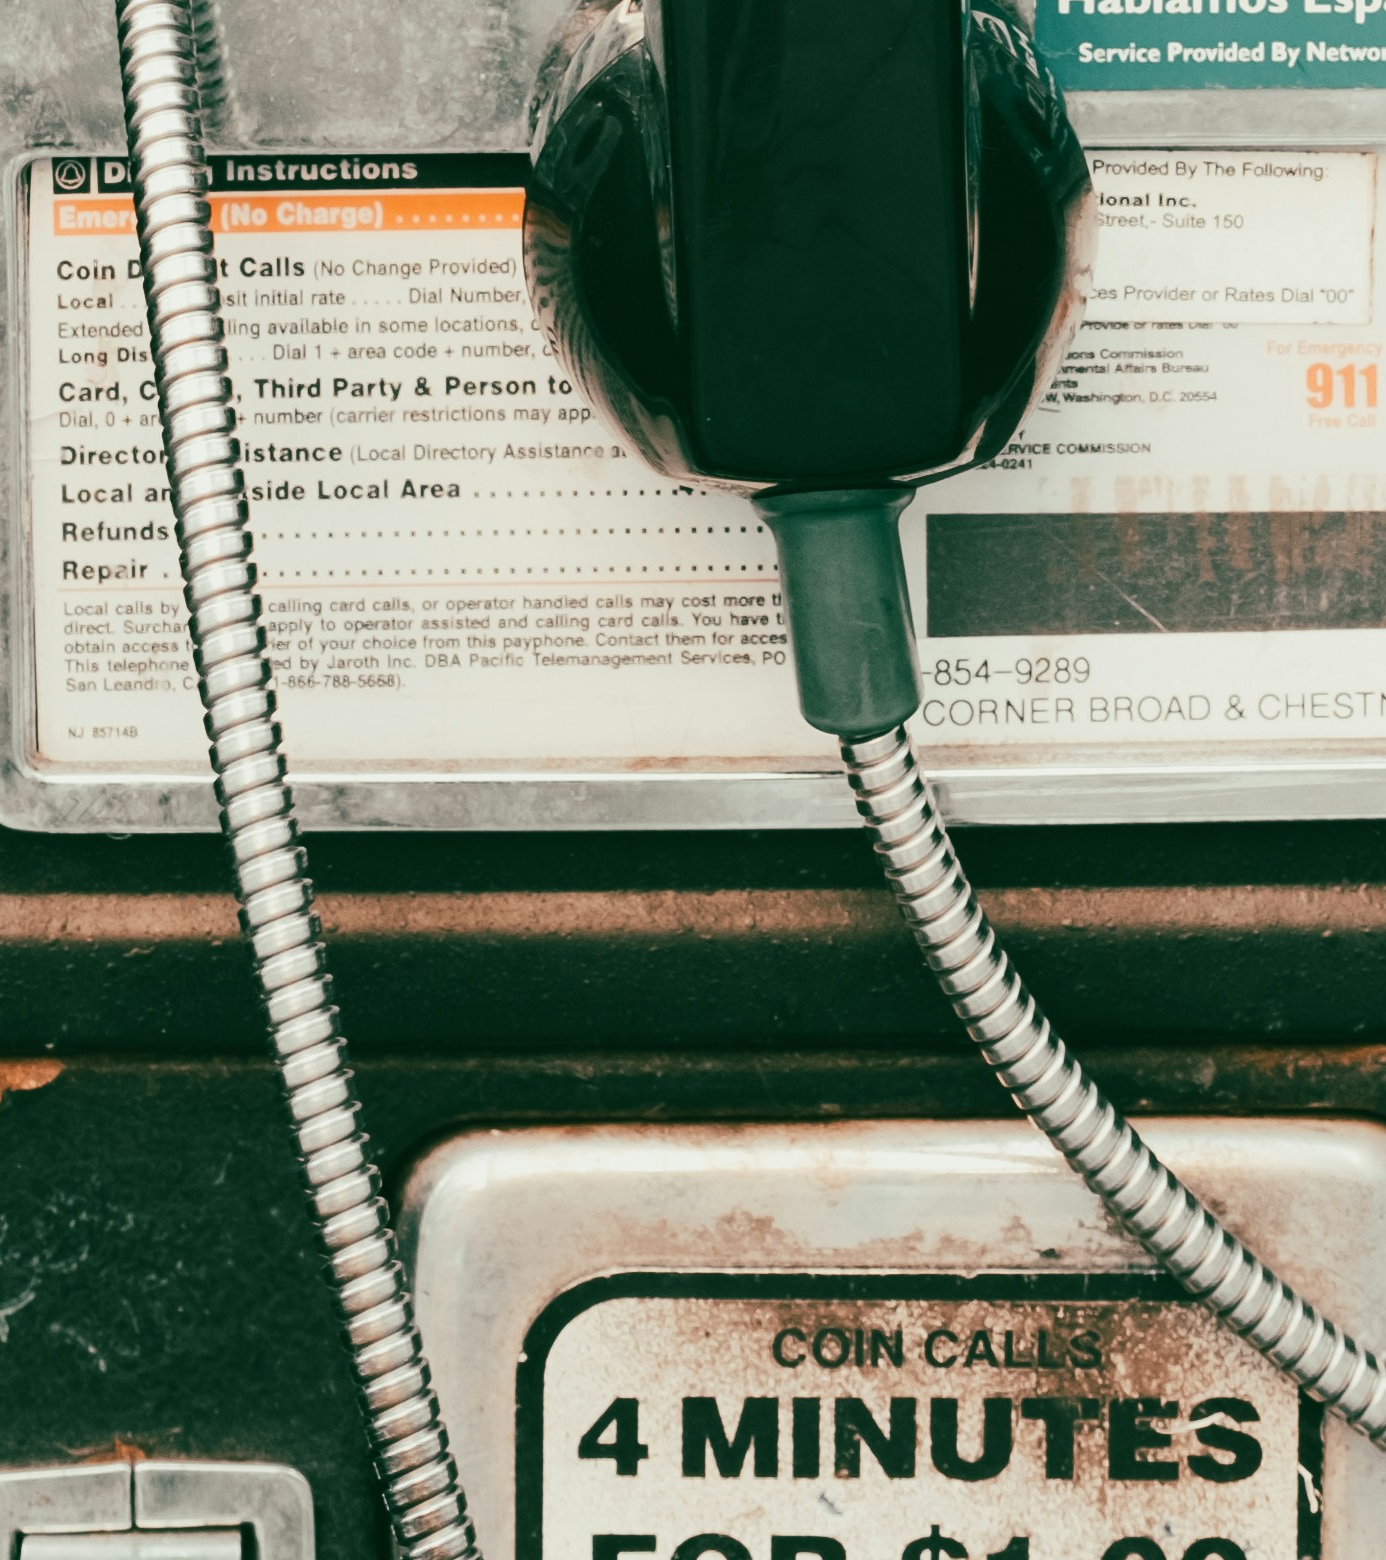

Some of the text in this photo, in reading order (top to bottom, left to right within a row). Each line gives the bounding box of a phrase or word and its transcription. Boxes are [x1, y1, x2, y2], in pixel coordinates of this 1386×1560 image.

[1078, 43, 1161, 63] Service
[1167, 42, 1265, 63] Provided
[1271, 42, 1299, 68] By
[226, 160, 418, 184] Instructions
[1093, 160, 1168, 176] Provided
[1176, 162, 1196, 179] By
[1204, 161, 1235, 177] The
[221, 201, 384, 229] (No Charge)
[1164, 213, 1244, 229] Suite 150
[57, 260, 115, 280] Coin
[240, 257, 516, 279] Calls (No Change Provided)
[58, 294, 113, 309] Local
[255, 375, 572, 401] Third Party & Person to
[1305, 363, 1378, 409] 911
[62, 522, 169, 542] Refunds
[64, 560, 147, 584] Repair
[923, 698, 1074, 727] CORNER
[1090, 694, 1211, 723] BROAD
[1225, 695, 1245, 720] &
[772, 1327, 1104, 1369] COIN CALLS
[578, 1395, 1264, 1483] 4 MINUTES
